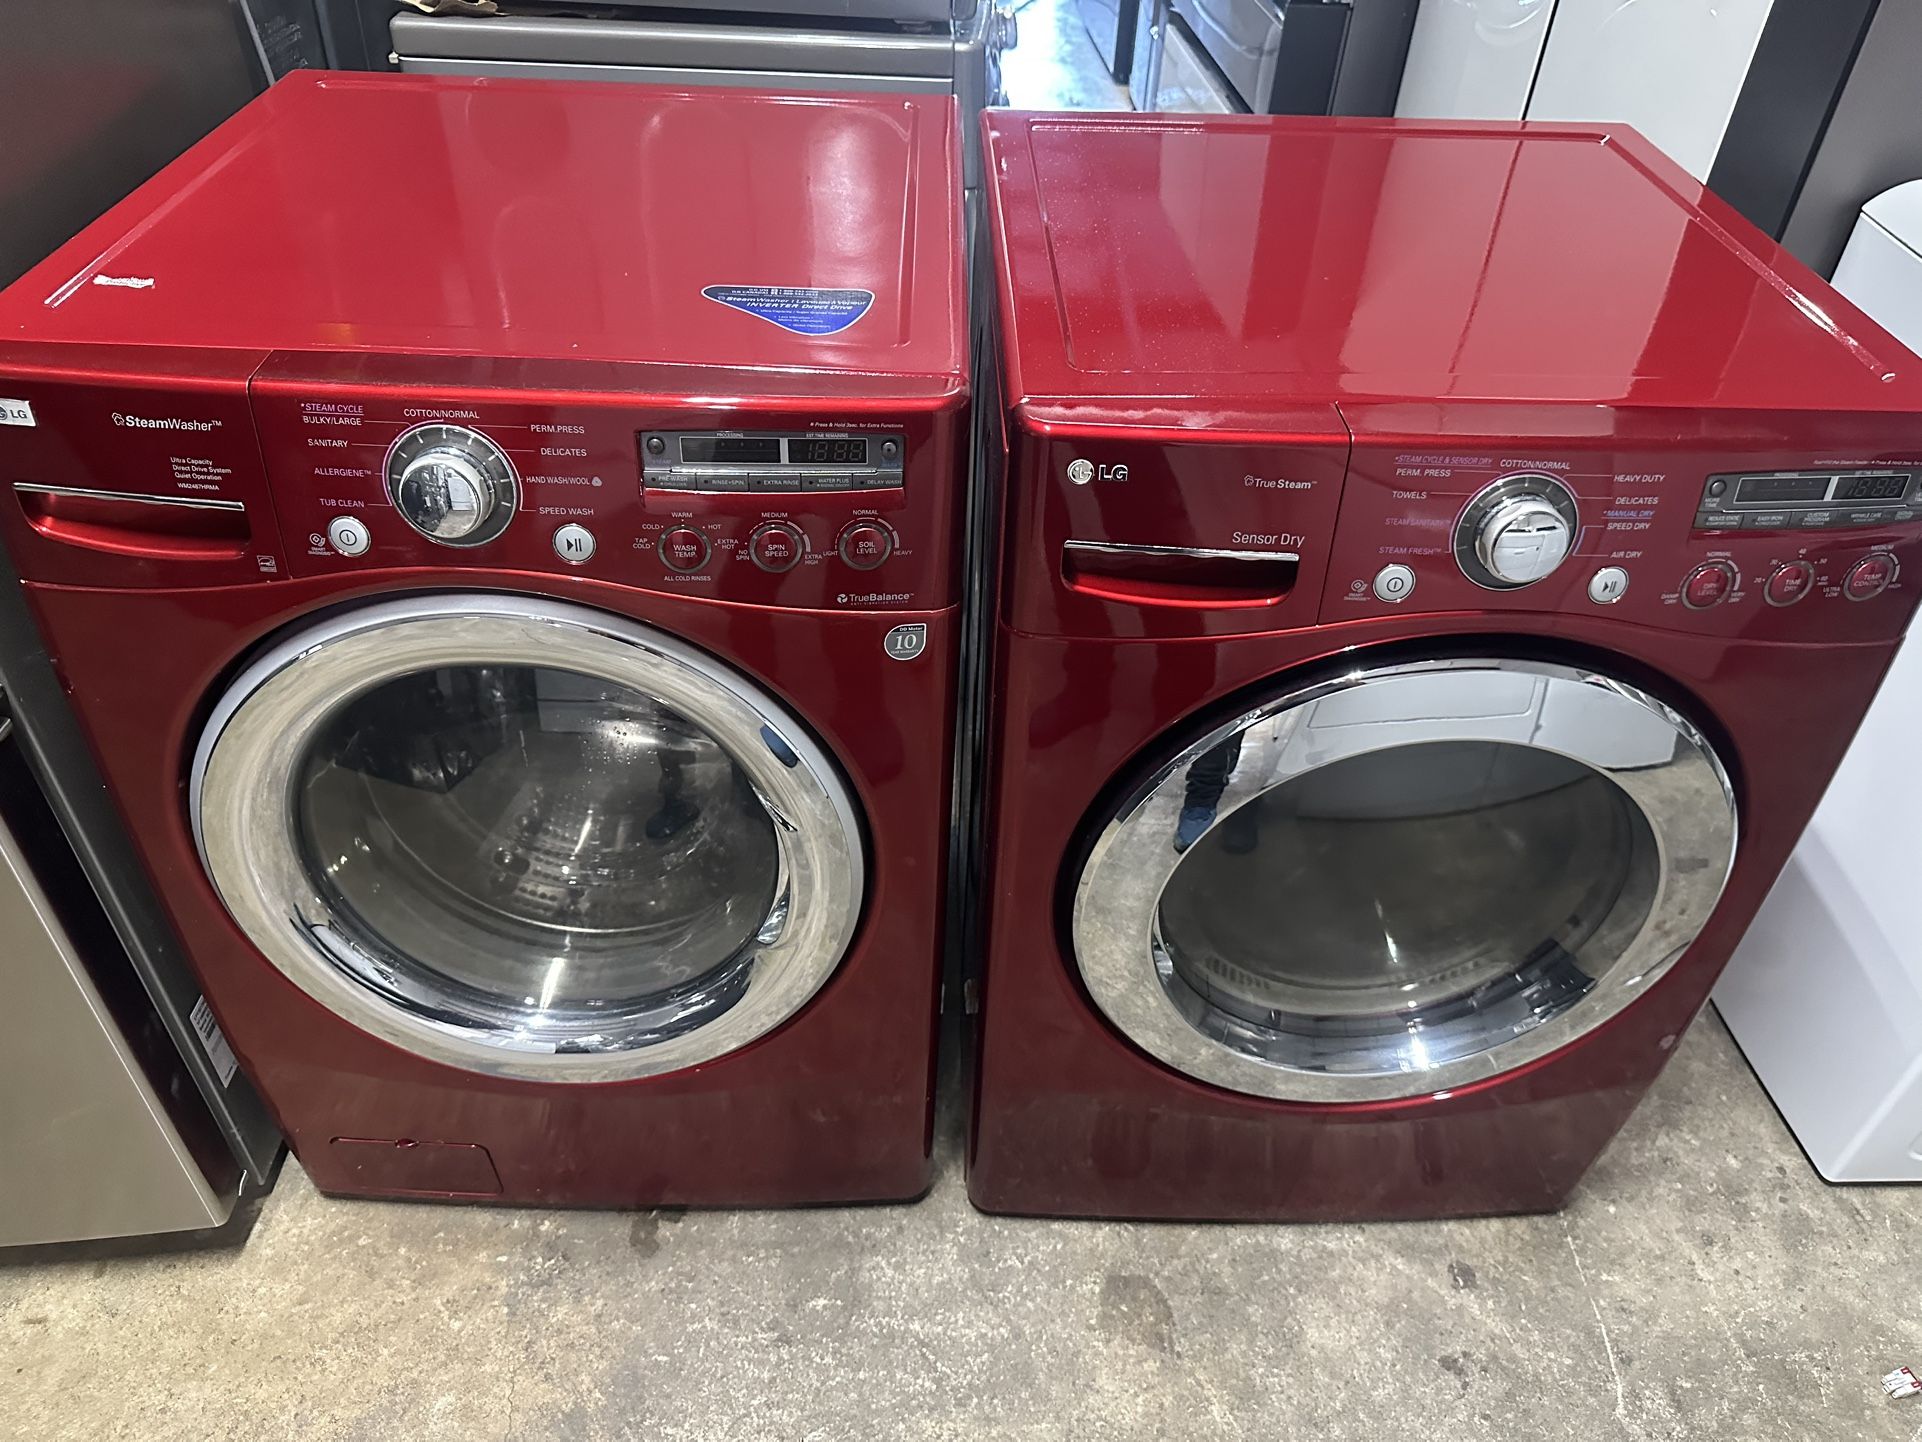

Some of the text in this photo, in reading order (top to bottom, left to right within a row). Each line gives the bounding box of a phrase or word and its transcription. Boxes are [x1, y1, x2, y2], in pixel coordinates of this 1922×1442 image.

[337, 404, 364, 413] CYCLE
[404, 408, 480, 419] COTTON/NORMAL
[10, 410, 28, 418] LG
[302, 416, 362, 426] BULKY/LARGE
[308, 438, 348, 448] SANITARY
[540, 448, 587, 457] DELICATES
[1422, 456, 1444, 464] CYCLE
[1500, 460, 1570, 470] COTTON/NORMAL
[1098, 464, 1128, 481] LG
[1396, 468, 1422, 476] PERM.
[526, 476, 590, 486] HAND WASH/WOOL
[1642, 474, 1666, 482] DUTY
[1392, 491, 1428, 499] TOWELS
[1615, 496, 1659, 504] DELICATES
[320, 498, 364, 508] TUB CLEAN
[539, 506, 594, 516] SPEED WASH
[1606, 522, 1632, 530] SPEED
[1232, 531, 1305, 547] Sensor Dry
[894, 634, 916, 650] 10
